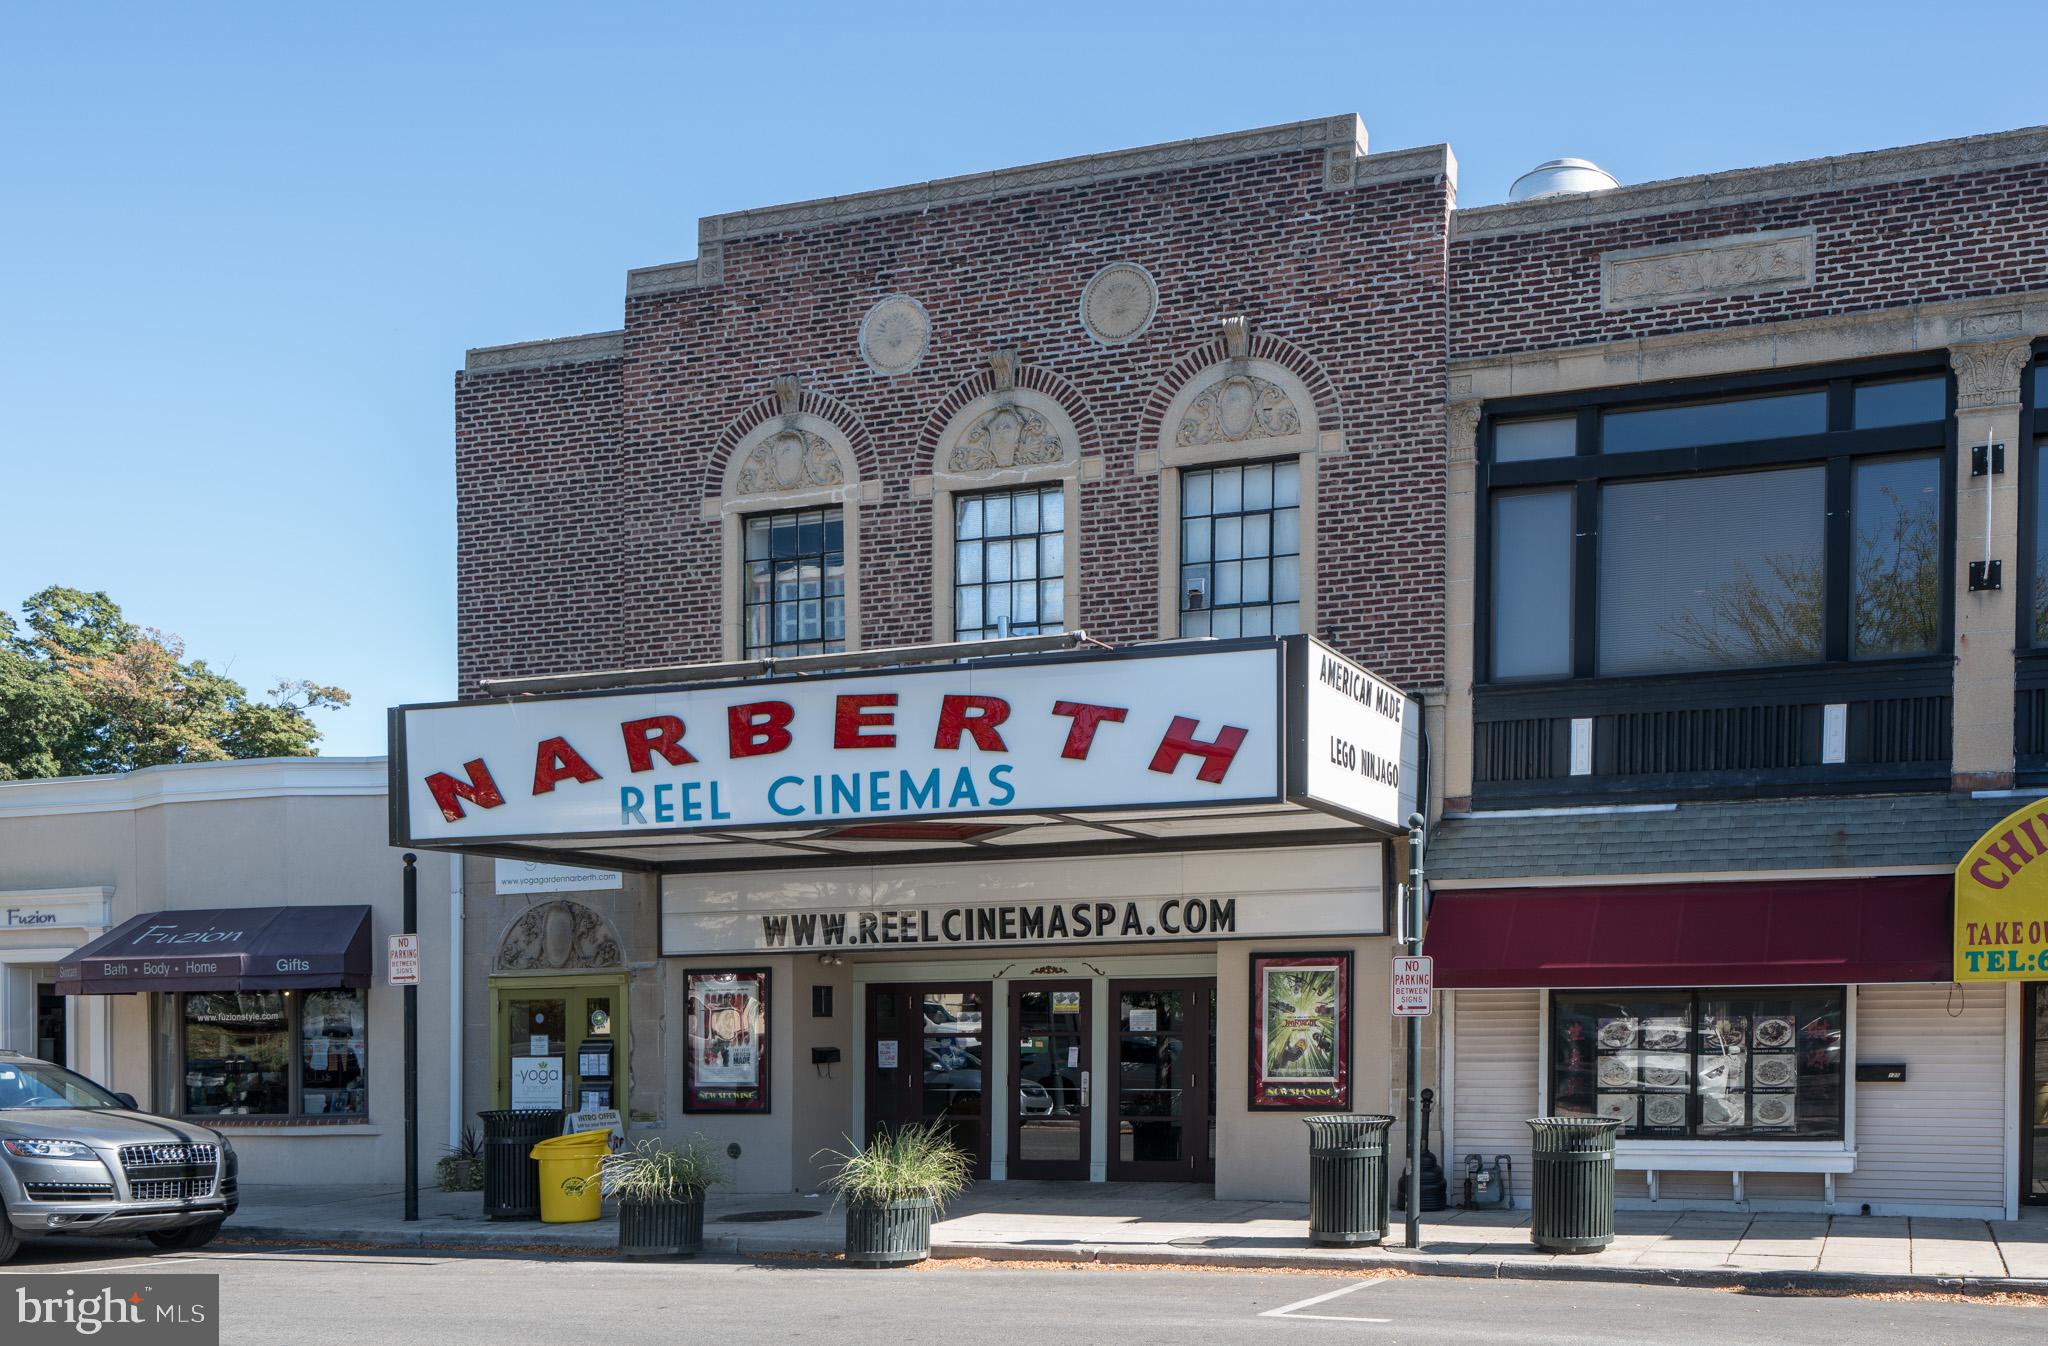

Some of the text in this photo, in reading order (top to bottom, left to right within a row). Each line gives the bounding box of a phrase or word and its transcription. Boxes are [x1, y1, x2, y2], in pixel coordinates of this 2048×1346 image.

[1320, 654, 1400, 723] AMERICAN MADE
[423, 693, 1249, 823] NARBERTH
[1330, 735, 1399, 788] LEGO NINJAGO
[620, 765, 1016, 825] REEL CINEMAS
[502, 873, 616, 886] www.yogagardennarberth.com
[7, 908, 56, 925] Fuzion
[762, 898, 1237, 947] WWW.REELCINEMASPA.COM
[132, 924, 243, 945] Fuzion
[1966, 921, 2024, 945] TAKE
[398, 938, 409, 947] NO
[391, 949, 417, 959] PARKING
[104, 961, 217, 977] Bath Body Home
[276, 958, 310, 971] Gifts
[1405, 960, 1419, 971] NO
[1395, 974, 1429, 985] PARKING
[197, 1011, 279, 1023] www.fuzionstyle.com
[520, 1069, 559, 1084] yoga
[578, 1112, 616, 1122] INTRO OFFER
